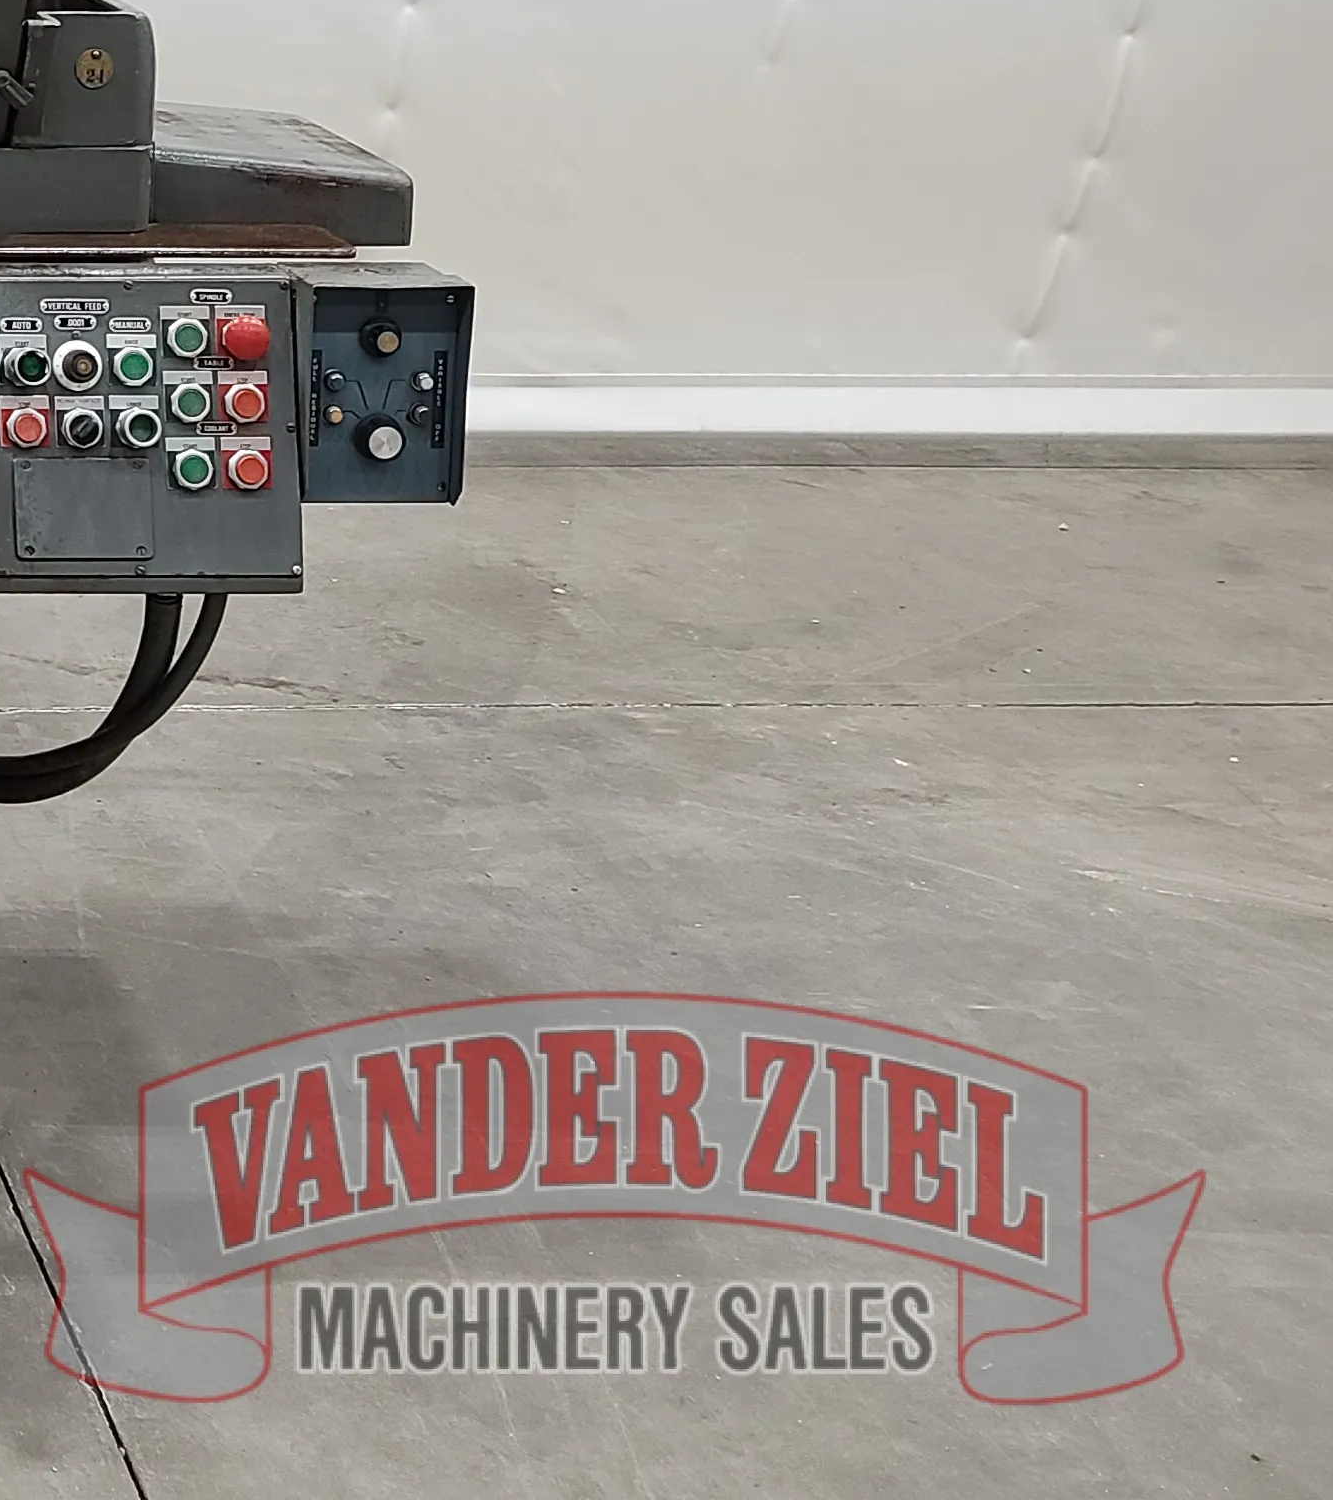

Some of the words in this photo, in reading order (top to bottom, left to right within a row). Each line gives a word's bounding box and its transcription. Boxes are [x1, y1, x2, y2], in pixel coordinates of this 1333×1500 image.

[47, 302, 82, 311] VERTICAL
[84, 302, 102, 311] FEED
[12, 321, 32, 330] AUTO
[115, 321, 145, 329] MANUAL
